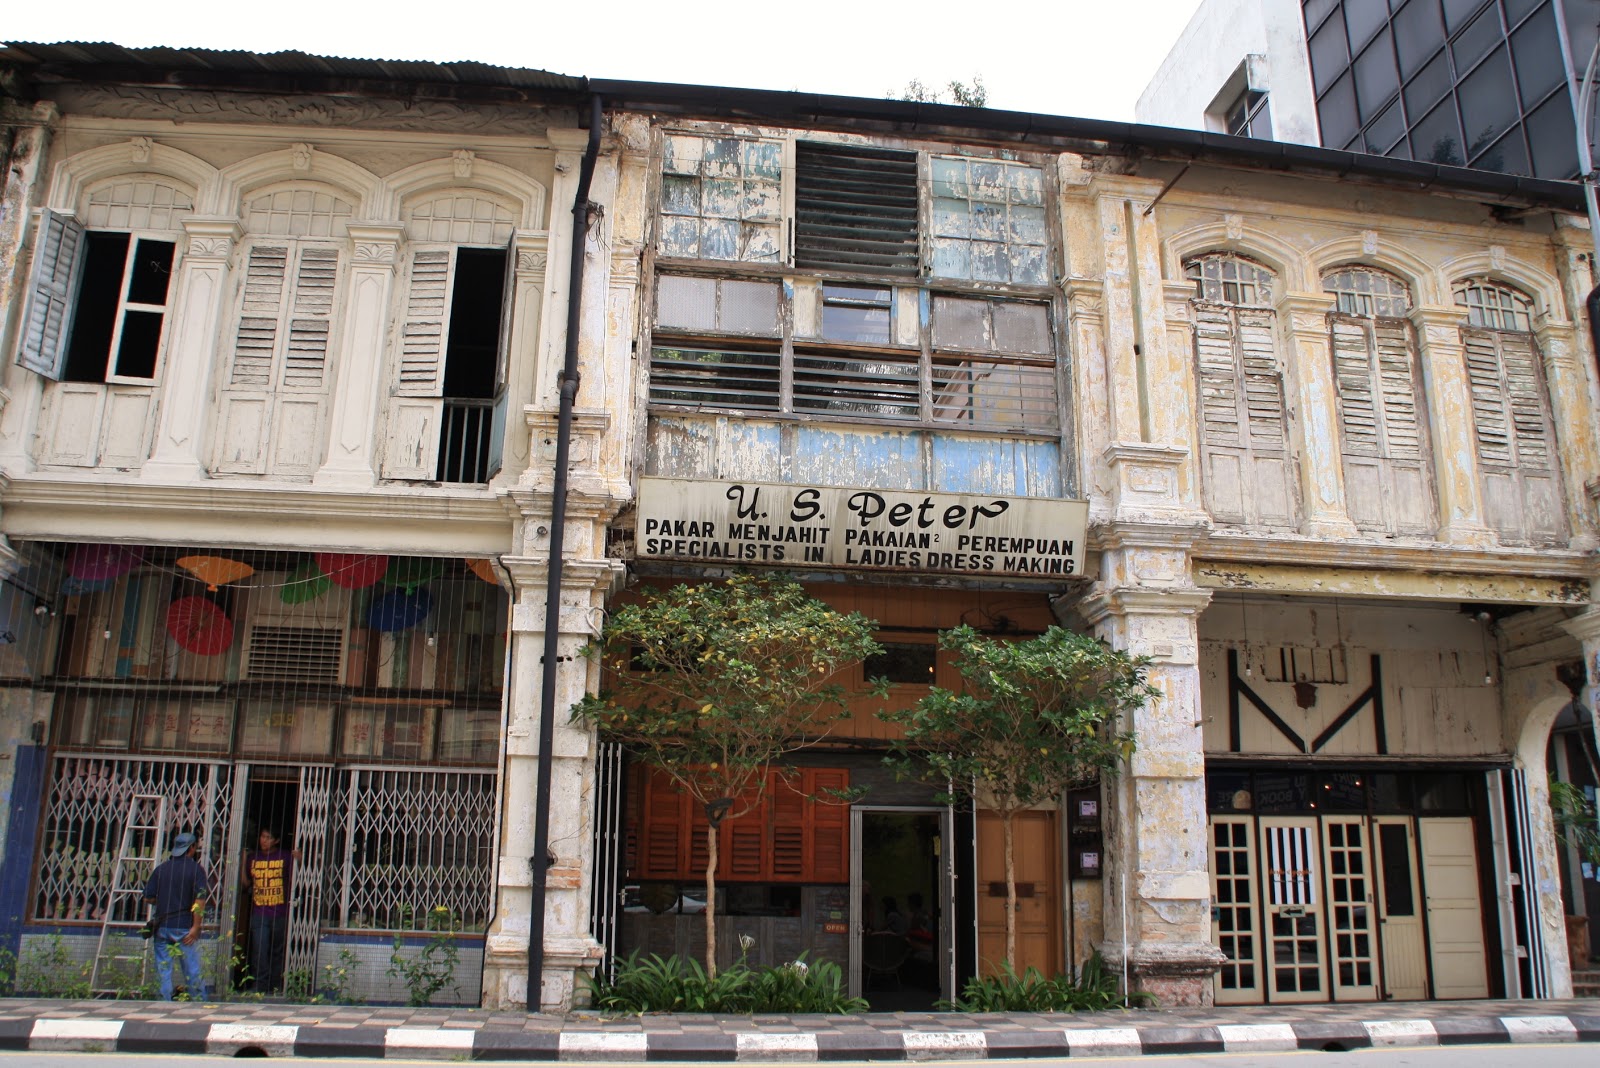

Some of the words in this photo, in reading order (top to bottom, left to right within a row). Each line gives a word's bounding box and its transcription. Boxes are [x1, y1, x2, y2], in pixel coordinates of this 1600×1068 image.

[726, 485, 768, 521] U.
[790, 488, 826, 522] S.
[847, 491, 1010, 530] Peter
[645, 518, 715, 539] PAKAR
[728, 522, 831, 545] MENJAHIT
[957, 534, 1074, 556] PEREMPUAN
[645, 538, 785, 561] SPECIALISTS
[804, 546, 825, 563] IN
[844, 548, 921, 568] LADIES
[926, 550, 995, 571] DRESS
[1002, 555, 1076, 575] MAKING
[269, 860, 284, 868] not
